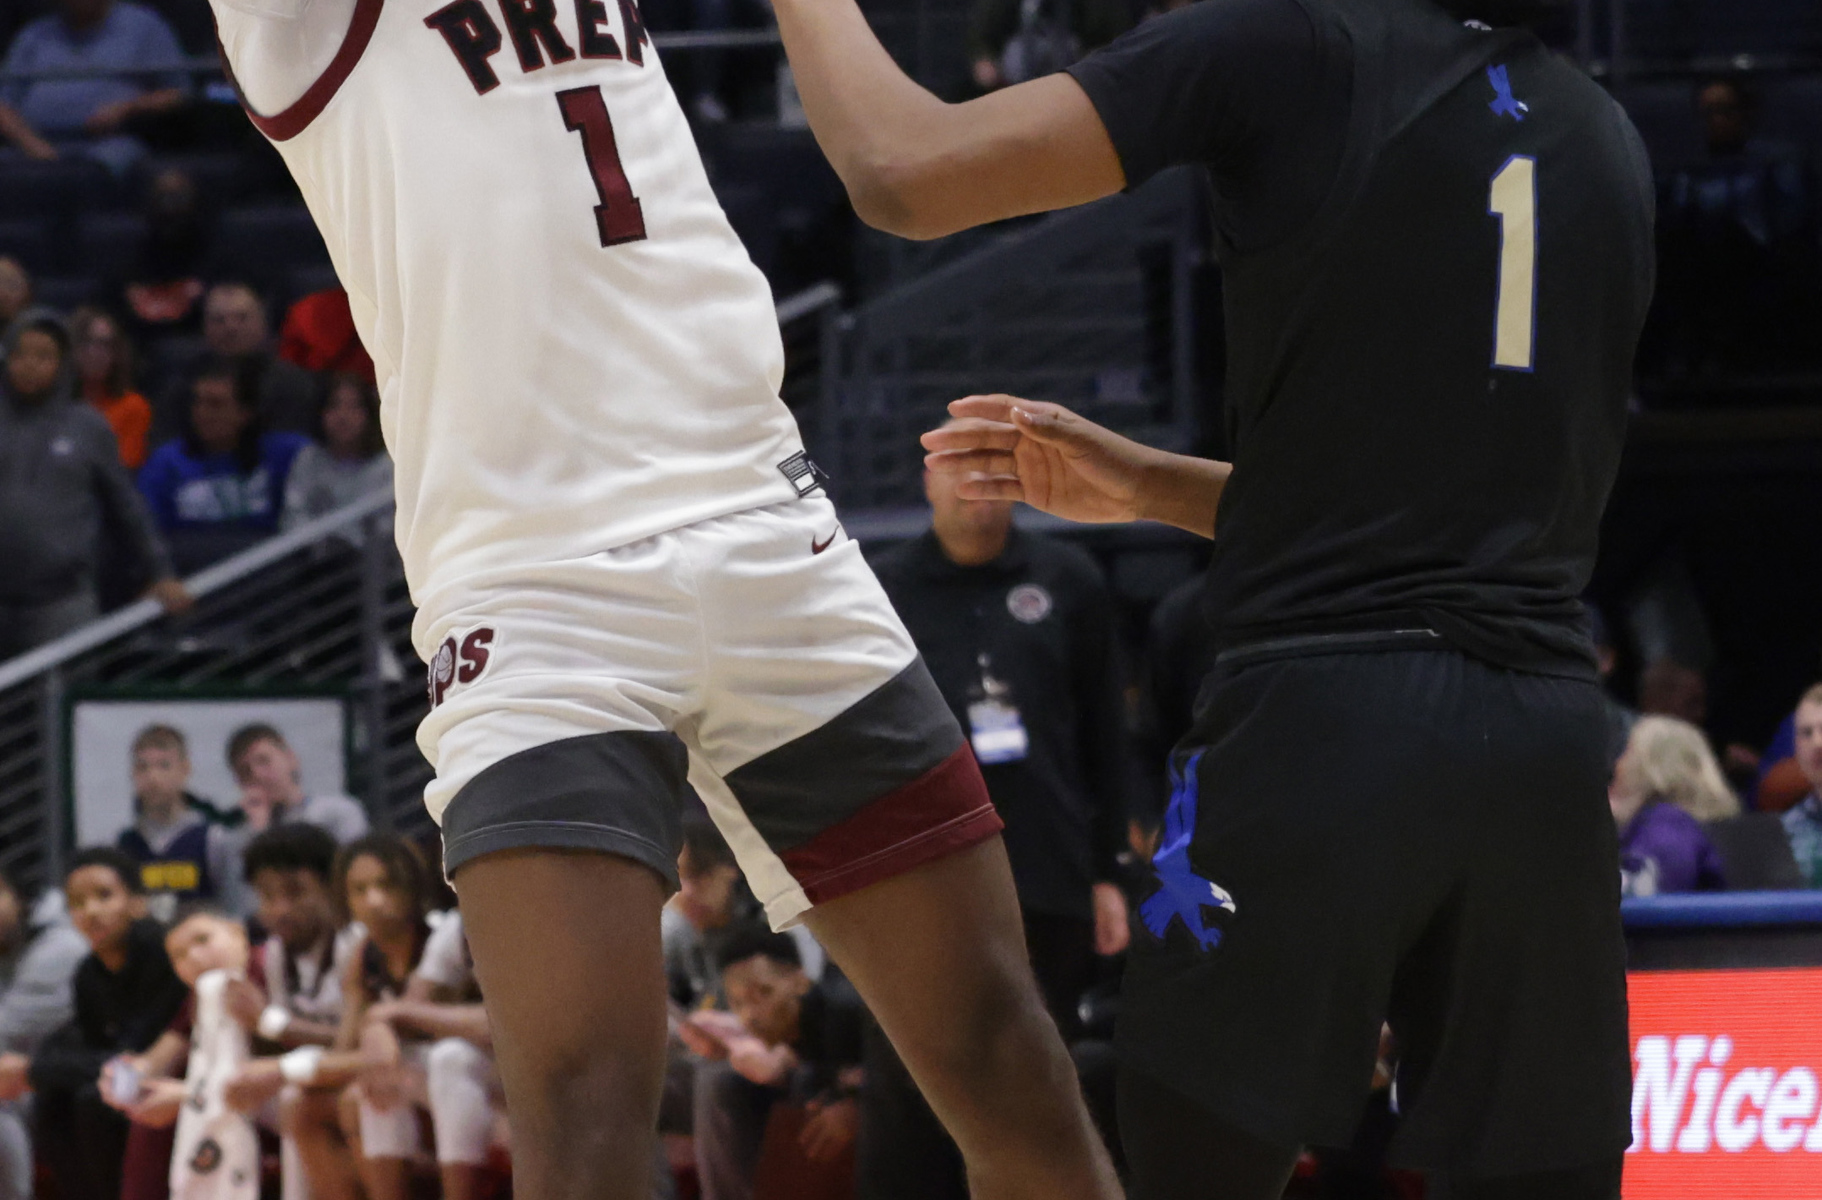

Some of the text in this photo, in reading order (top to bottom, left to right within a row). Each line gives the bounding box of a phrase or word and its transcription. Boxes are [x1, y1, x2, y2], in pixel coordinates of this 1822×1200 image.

[555, 85, 647, 248] 1
[1486, 154, 1538, 373] 1
[1626, 1035, 1822, 1153] Nice
